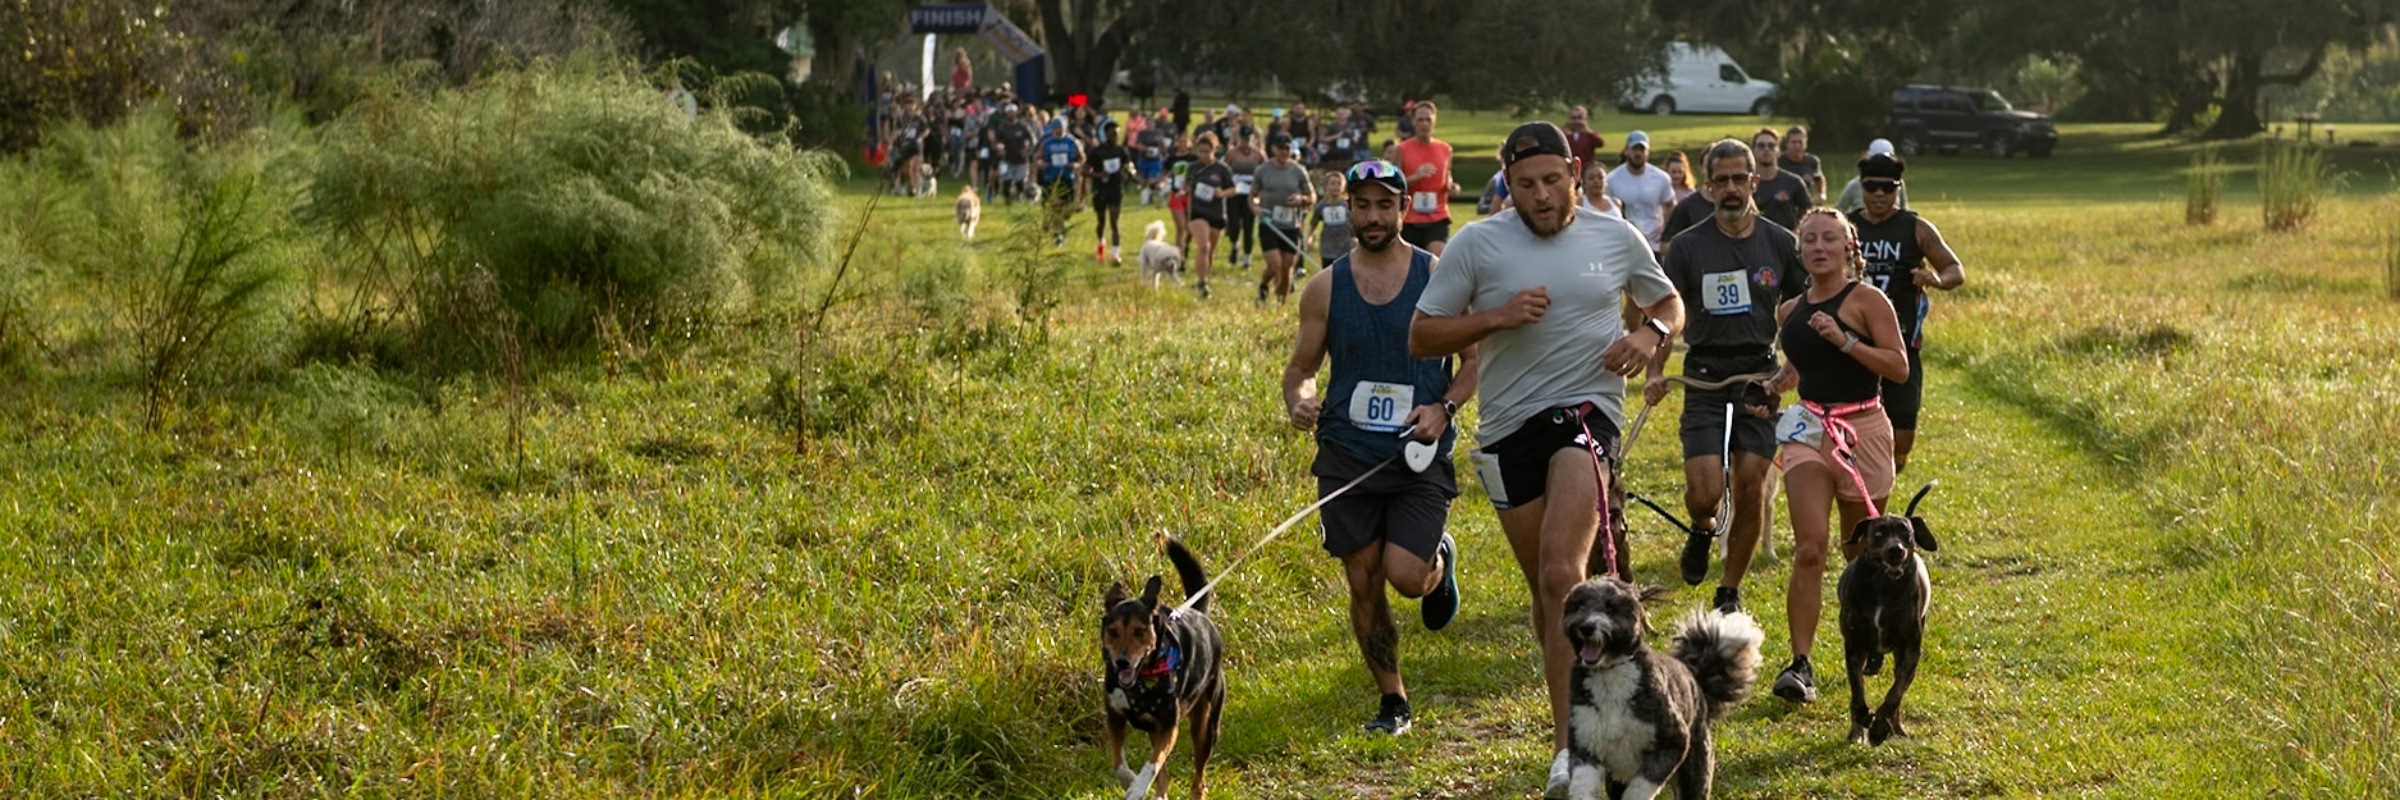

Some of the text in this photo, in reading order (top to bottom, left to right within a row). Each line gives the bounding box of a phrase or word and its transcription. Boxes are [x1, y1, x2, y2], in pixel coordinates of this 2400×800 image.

[910, 10, 981, 26] FINISH
[1717, 284, 1739, 305] 39
[1368, 396, 1394, 421] 60
[1789, 422, 1806, 441] 2
